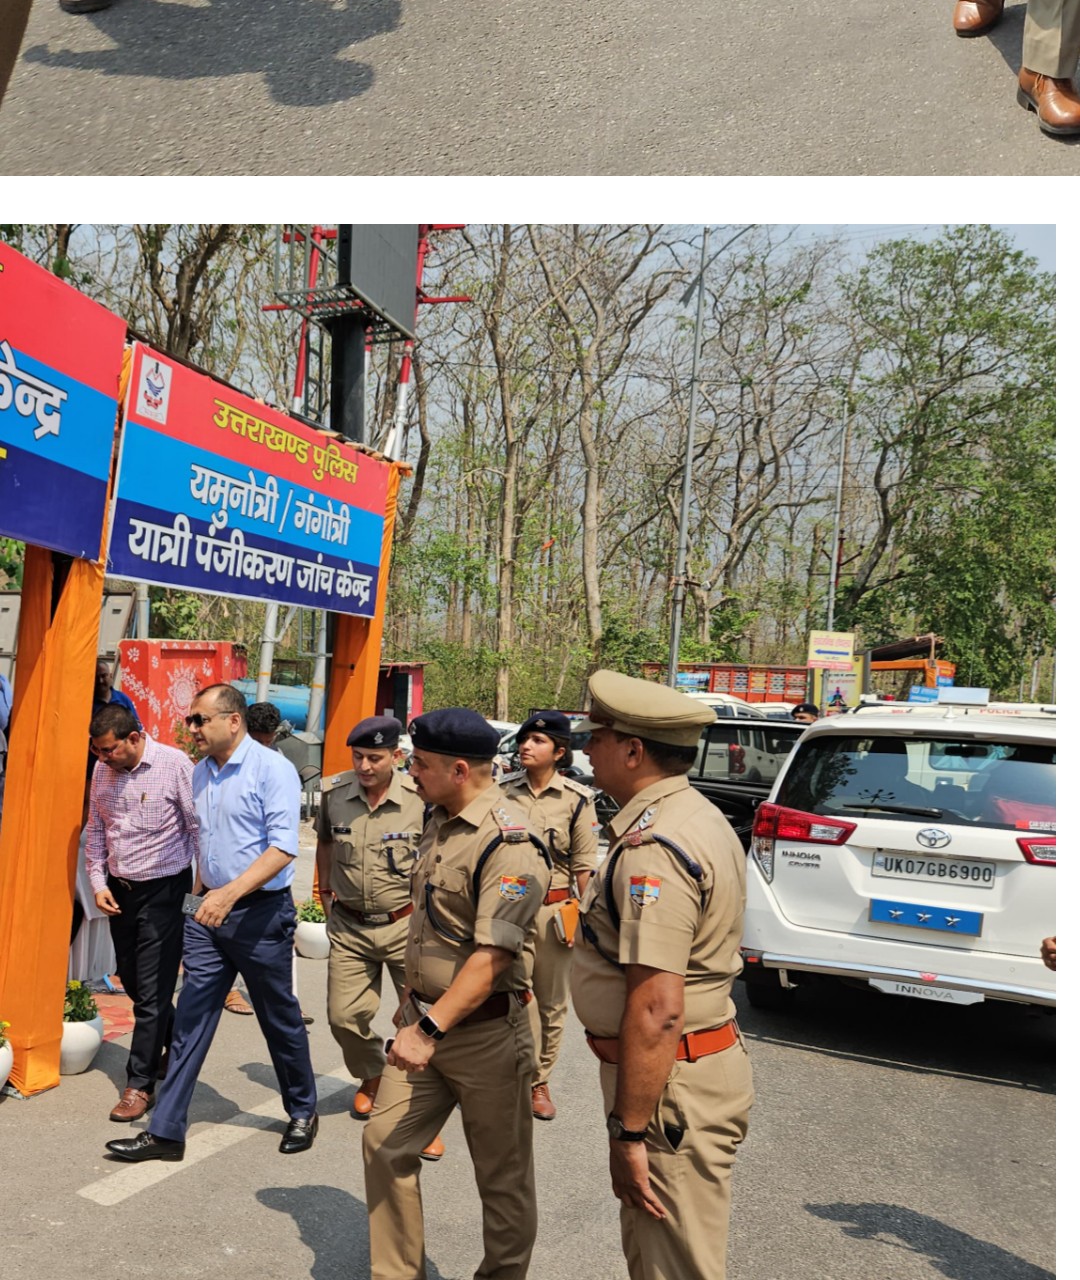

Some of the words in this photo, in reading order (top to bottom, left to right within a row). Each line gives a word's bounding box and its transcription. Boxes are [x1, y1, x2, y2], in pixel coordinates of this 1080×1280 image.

[213, 398, 310, 464] उत्तराखण्ड
[312, 444, 358, 484] पुलिस
[190, 464, 279, 529] यमुनोत्री
[294, 493, 351, 545] गंगोत्री
[128, 513, 192, 567] यात्री
[195, 524, 294, 587] पंजीकरण
[296, 553, 334, 595] जांच
[336, 560, 373, 607] केन्द्र
[884, 857, 992, 882] UK07GB6900
[896, 984, 954, 1000] INNOVA
